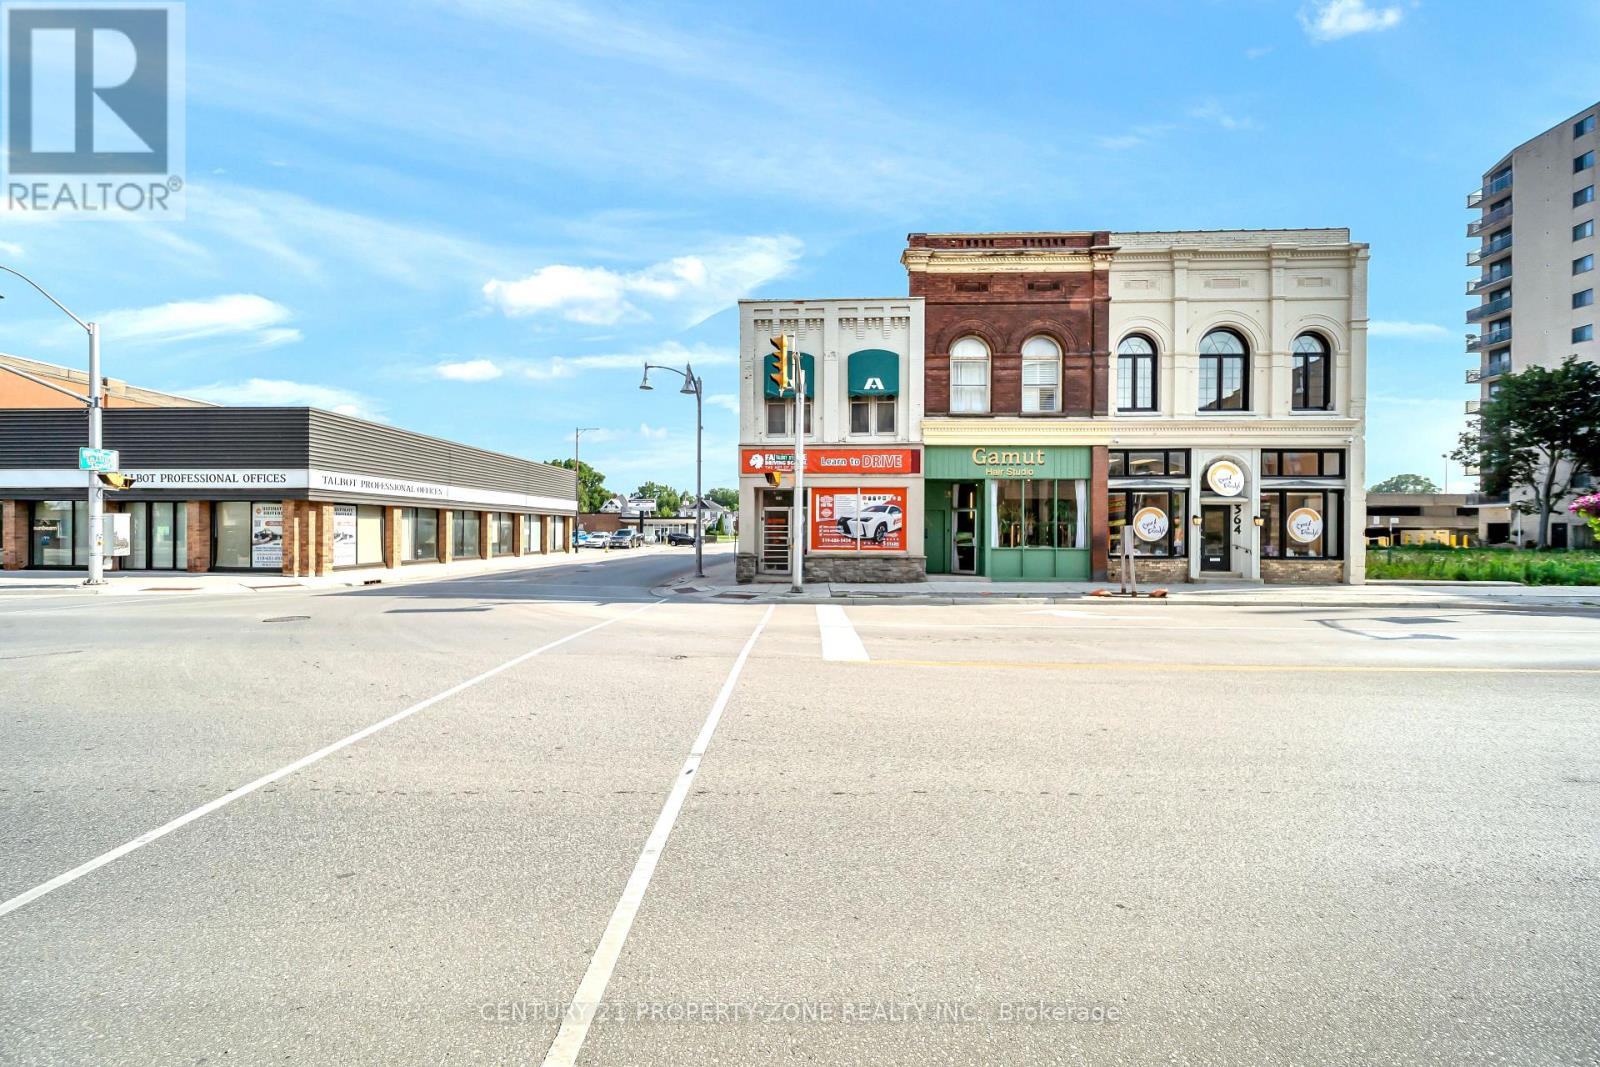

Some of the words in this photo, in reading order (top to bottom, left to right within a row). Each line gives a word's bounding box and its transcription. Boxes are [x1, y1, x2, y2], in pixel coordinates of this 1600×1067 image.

[820, 456, 848, 467] Learn
[850, 457, 861, 467] to
[862, 454, 903, 468] DRIVE
[972, 448, 1045, 466] Gamut
[160, 473, 238, 483] PROFESSIONAL
[243, 473, 286, 483] OFFICES
[1007, 468, 1034, 477] Studio
[321, 475, 357, 487] TALBOT
[360, 480, 415, 493] PROFESSIONAL
[416, 486, 443, 495] OFFICES
